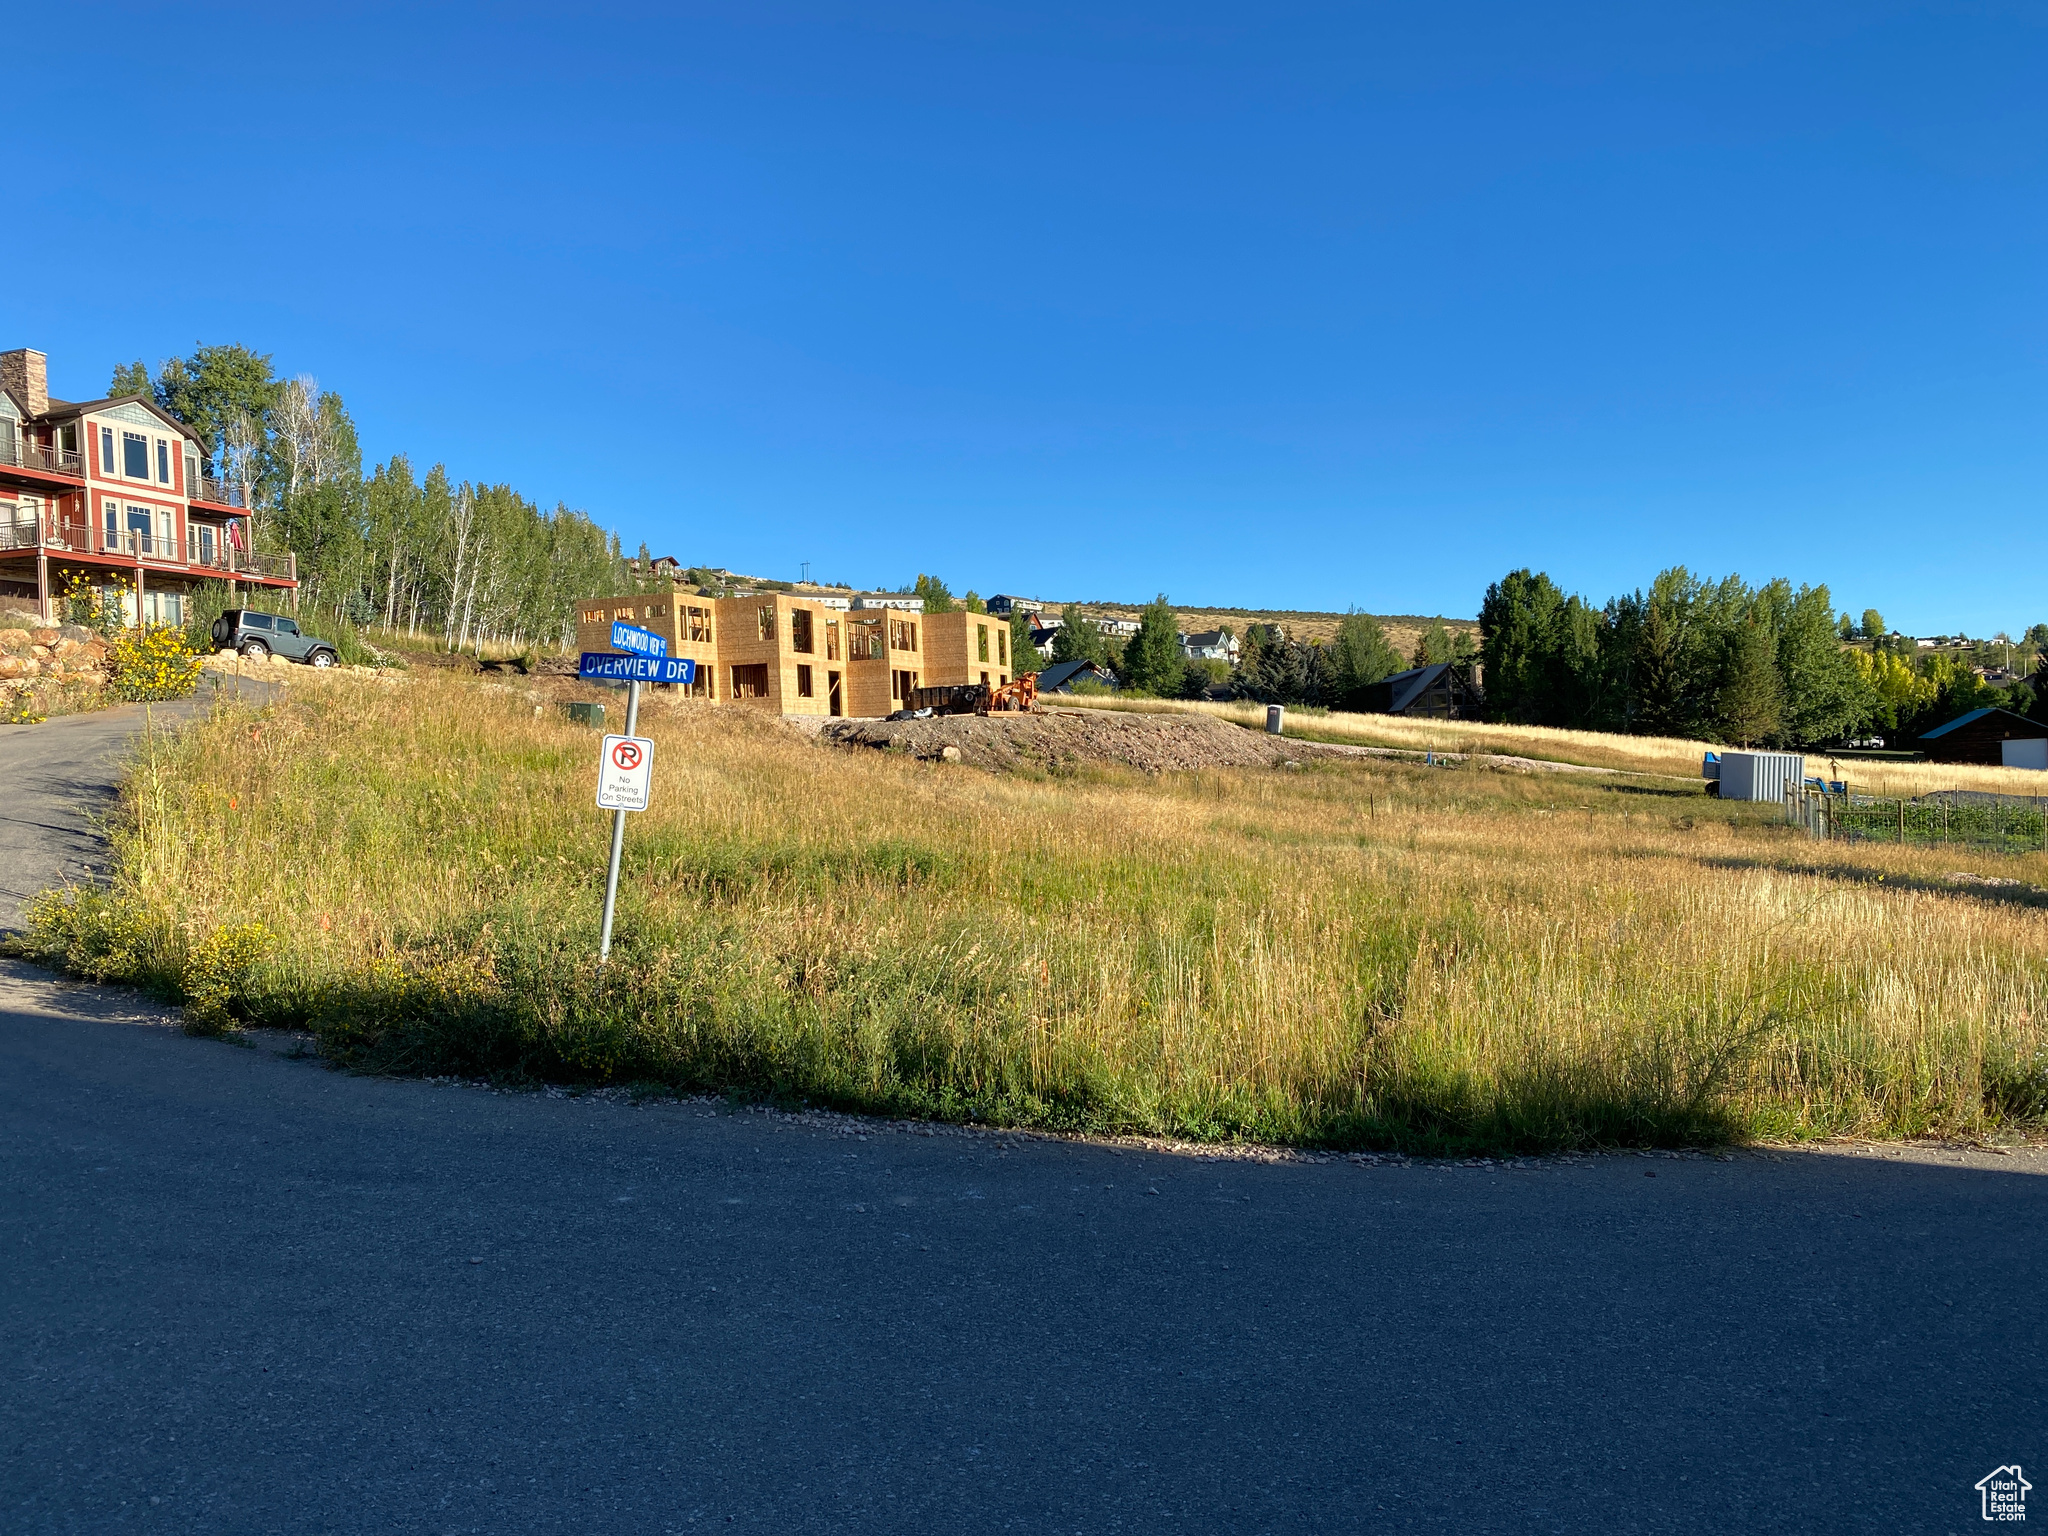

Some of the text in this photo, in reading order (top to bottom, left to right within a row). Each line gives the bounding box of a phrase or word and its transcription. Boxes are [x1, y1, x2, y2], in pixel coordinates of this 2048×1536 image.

[586, 656, 689, 680] OVERVIEW DR
[619, 775, 631, 784] No
[608, 784, 639, 796] Parking
[602, 793, 643, 804] On Streets
